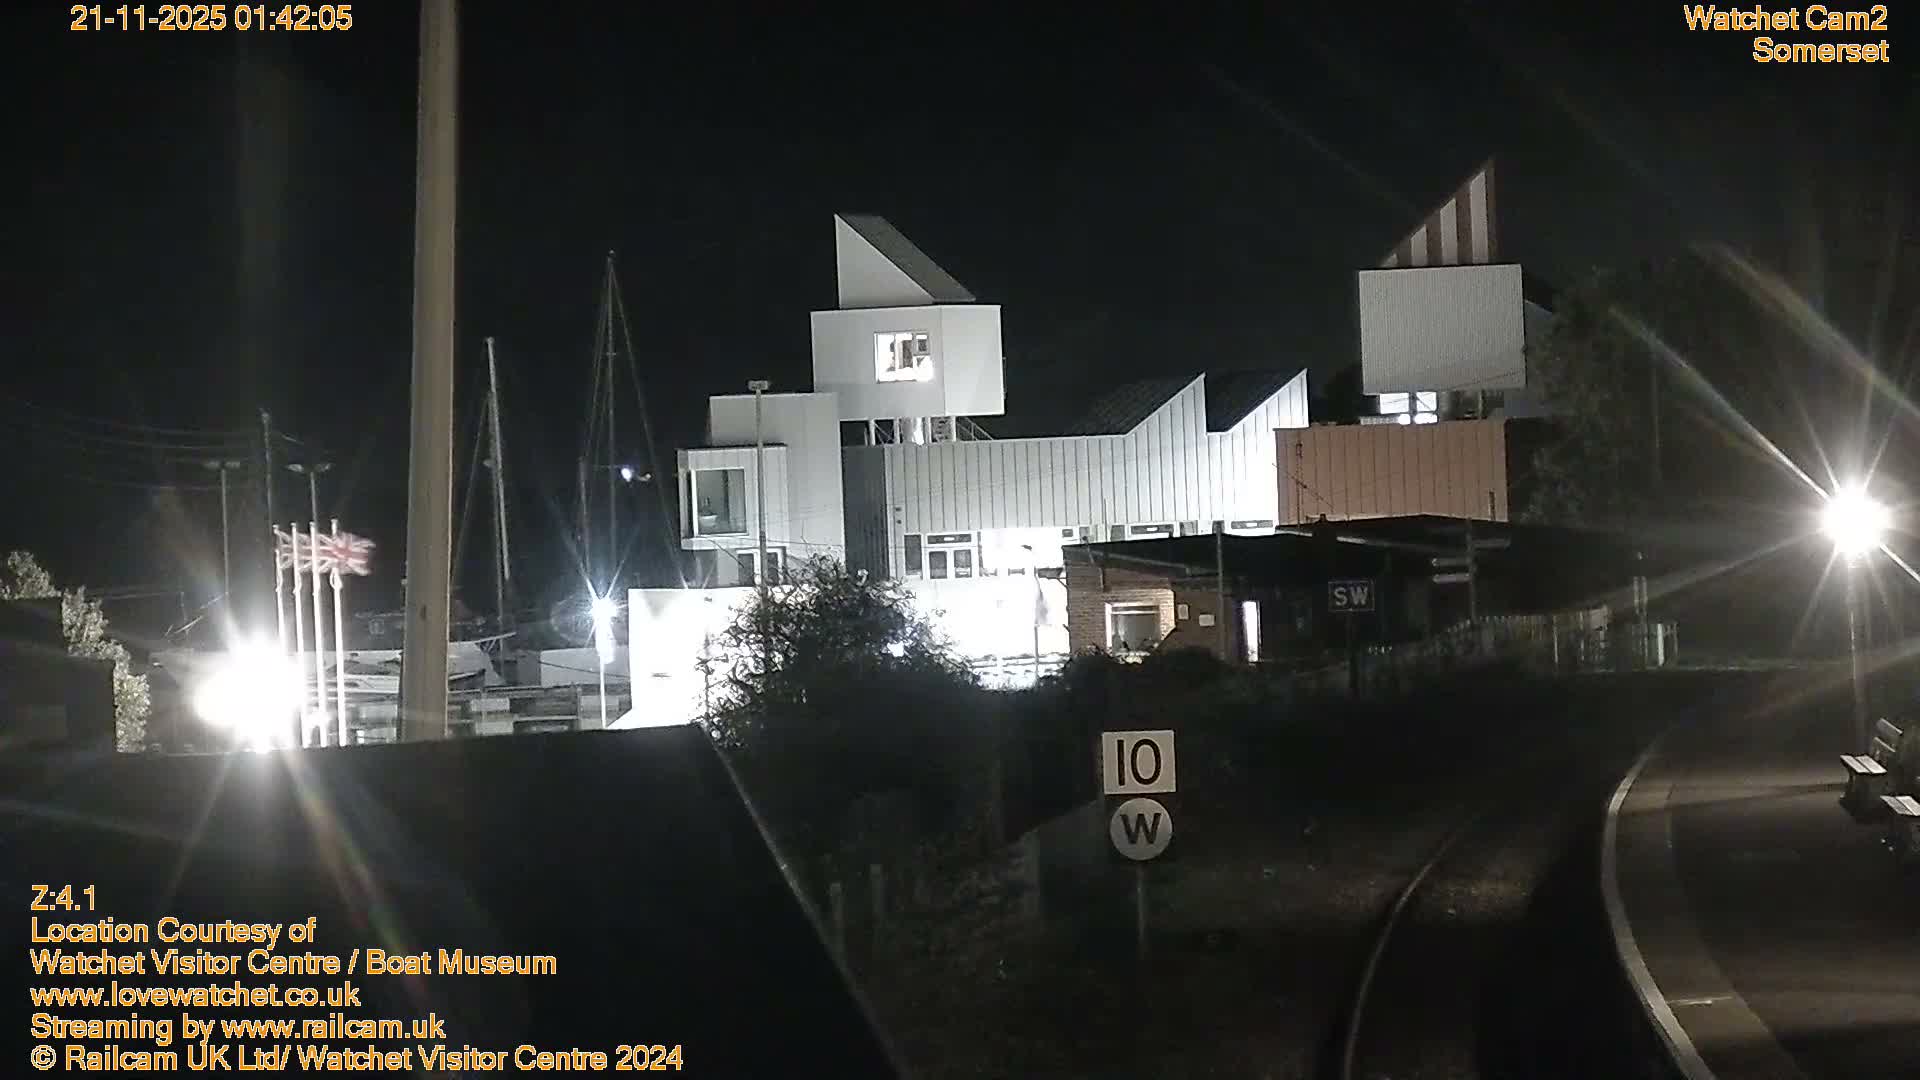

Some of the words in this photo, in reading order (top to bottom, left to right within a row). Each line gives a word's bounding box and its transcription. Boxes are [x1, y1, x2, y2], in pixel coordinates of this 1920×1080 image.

[1334, 586, 1368, 606] SW
[1117, 738, 1161, 786] 10
[1120, 812, 1161, 844] W
